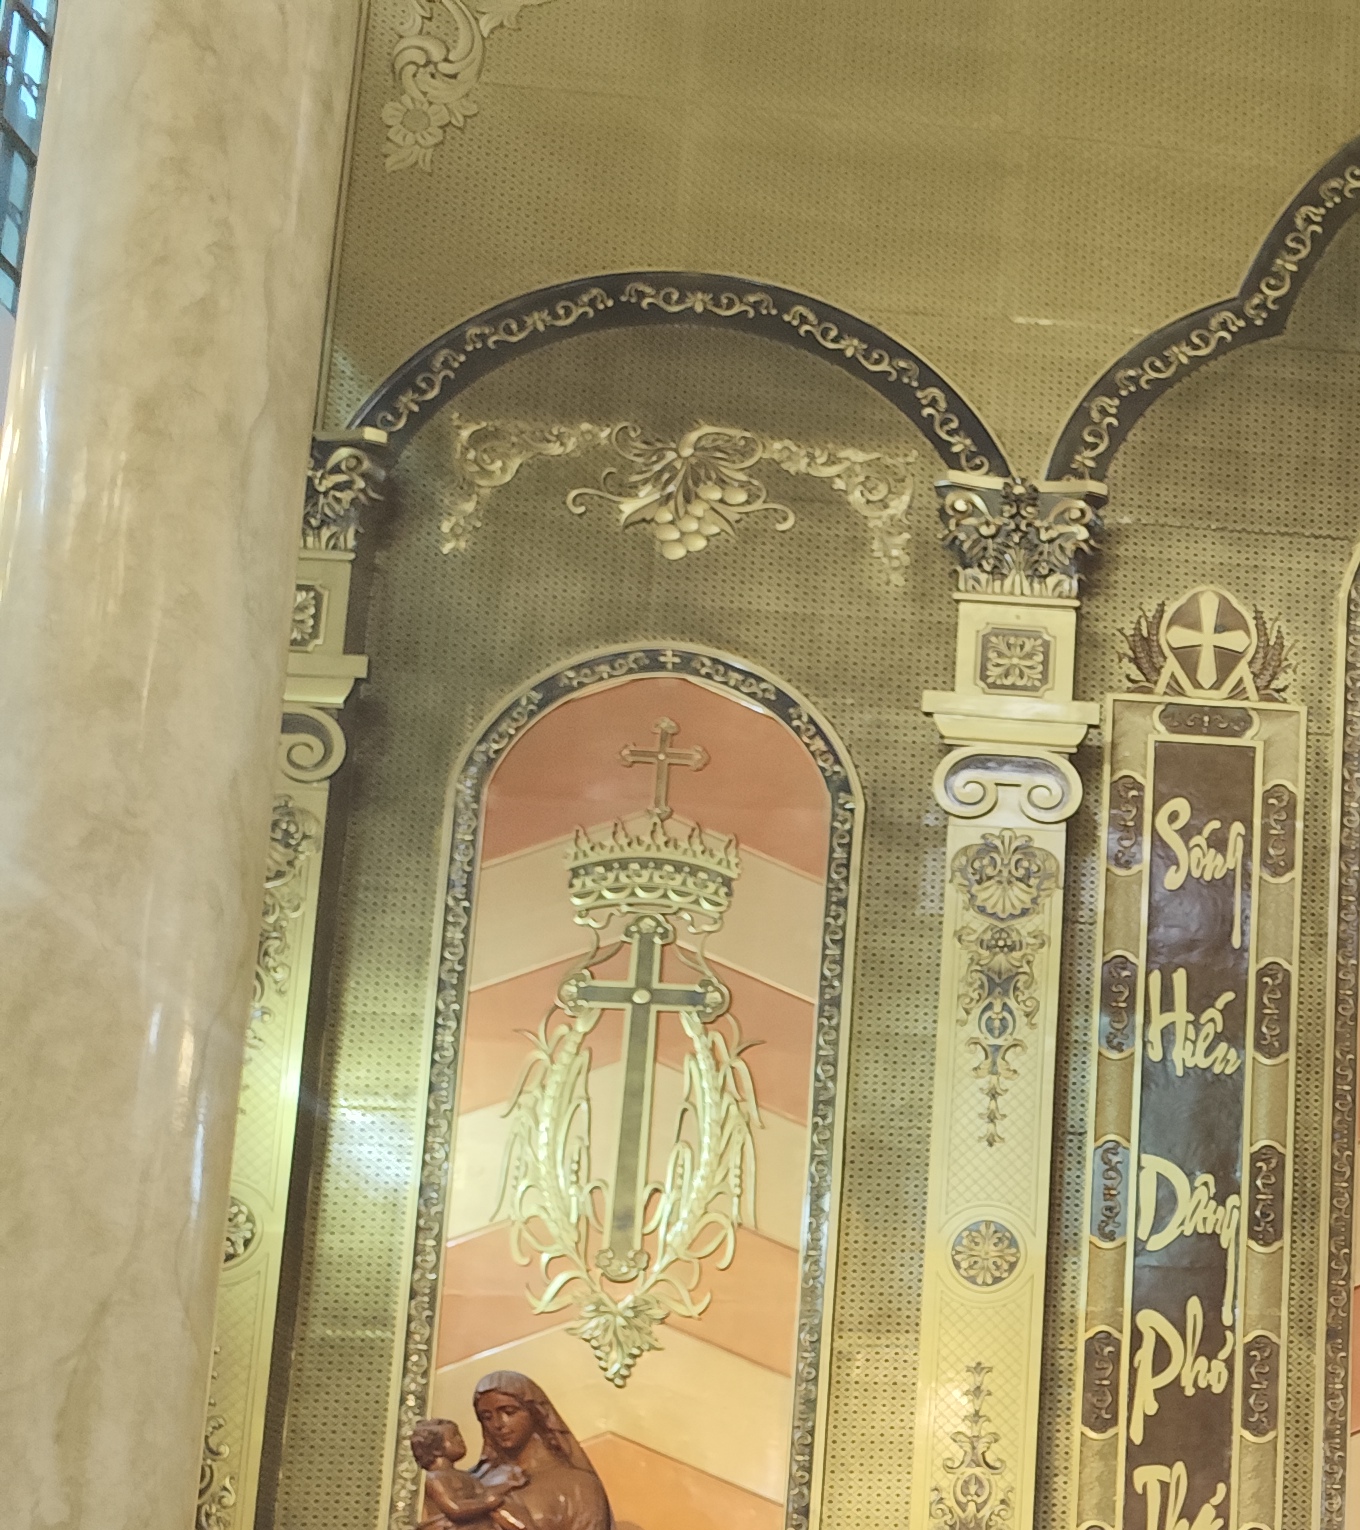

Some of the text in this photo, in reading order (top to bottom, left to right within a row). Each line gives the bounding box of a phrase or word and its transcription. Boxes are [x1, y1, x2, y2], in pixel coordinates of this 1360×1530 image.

[1155, 797, 1246, 950] Sống
[1147, 967, 1242, 1077] Hiến
[1137, 1153, 1241, 1327] Dâng
[1129, 1295, 1235, 1446] Phó
